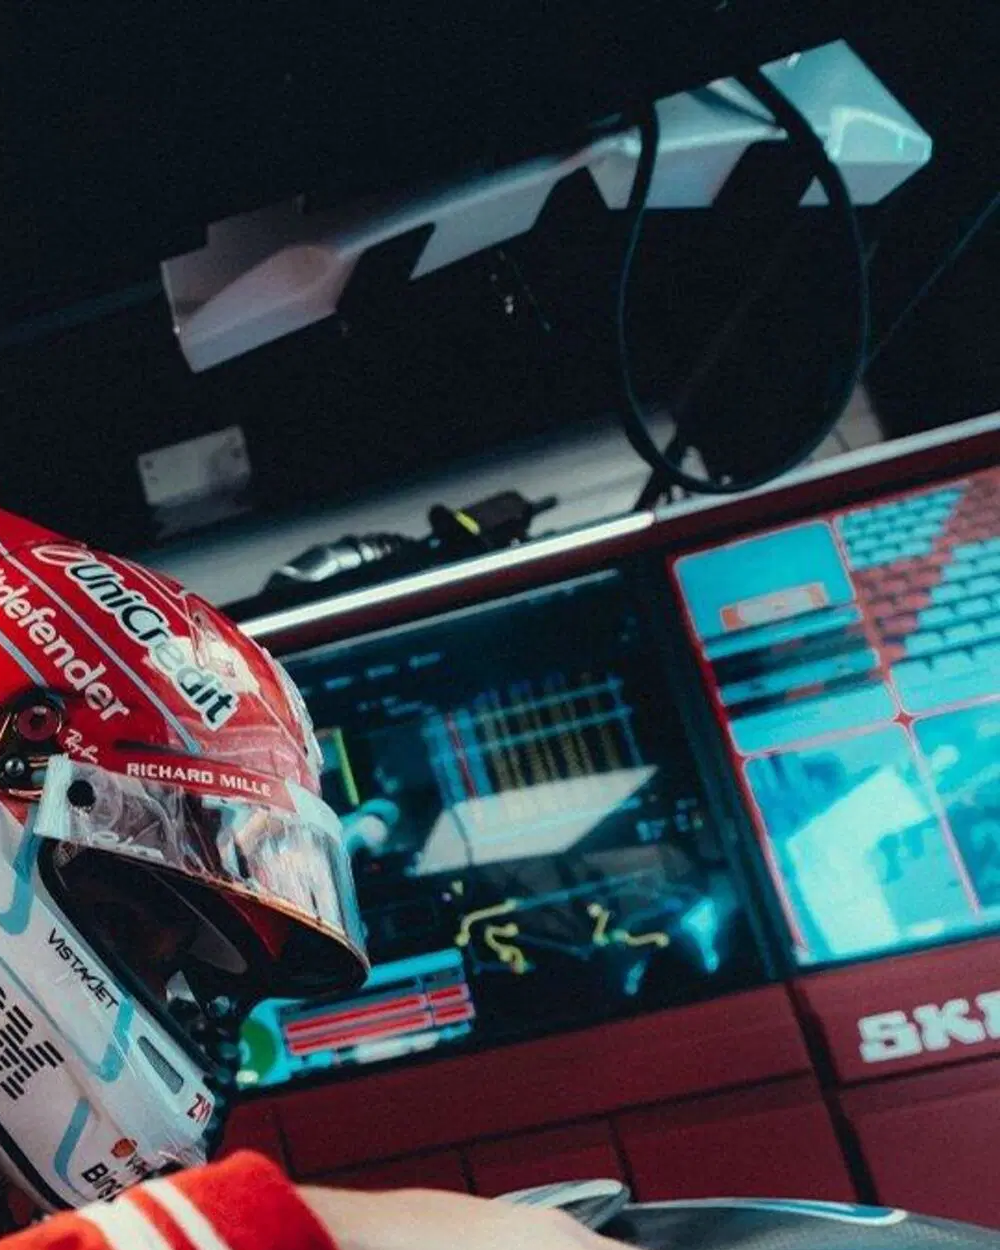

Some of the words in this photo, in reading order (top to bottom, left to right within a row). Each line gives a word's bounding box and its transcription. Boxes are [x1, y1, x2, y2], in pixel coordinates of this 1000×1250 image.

[66, 562, 237, 729] UniCredit
[126, 761, 214, 785] RICHARD
[219, 773, 272, 798] MILLE
[48, 927, 119, 1010] VISTAJET
